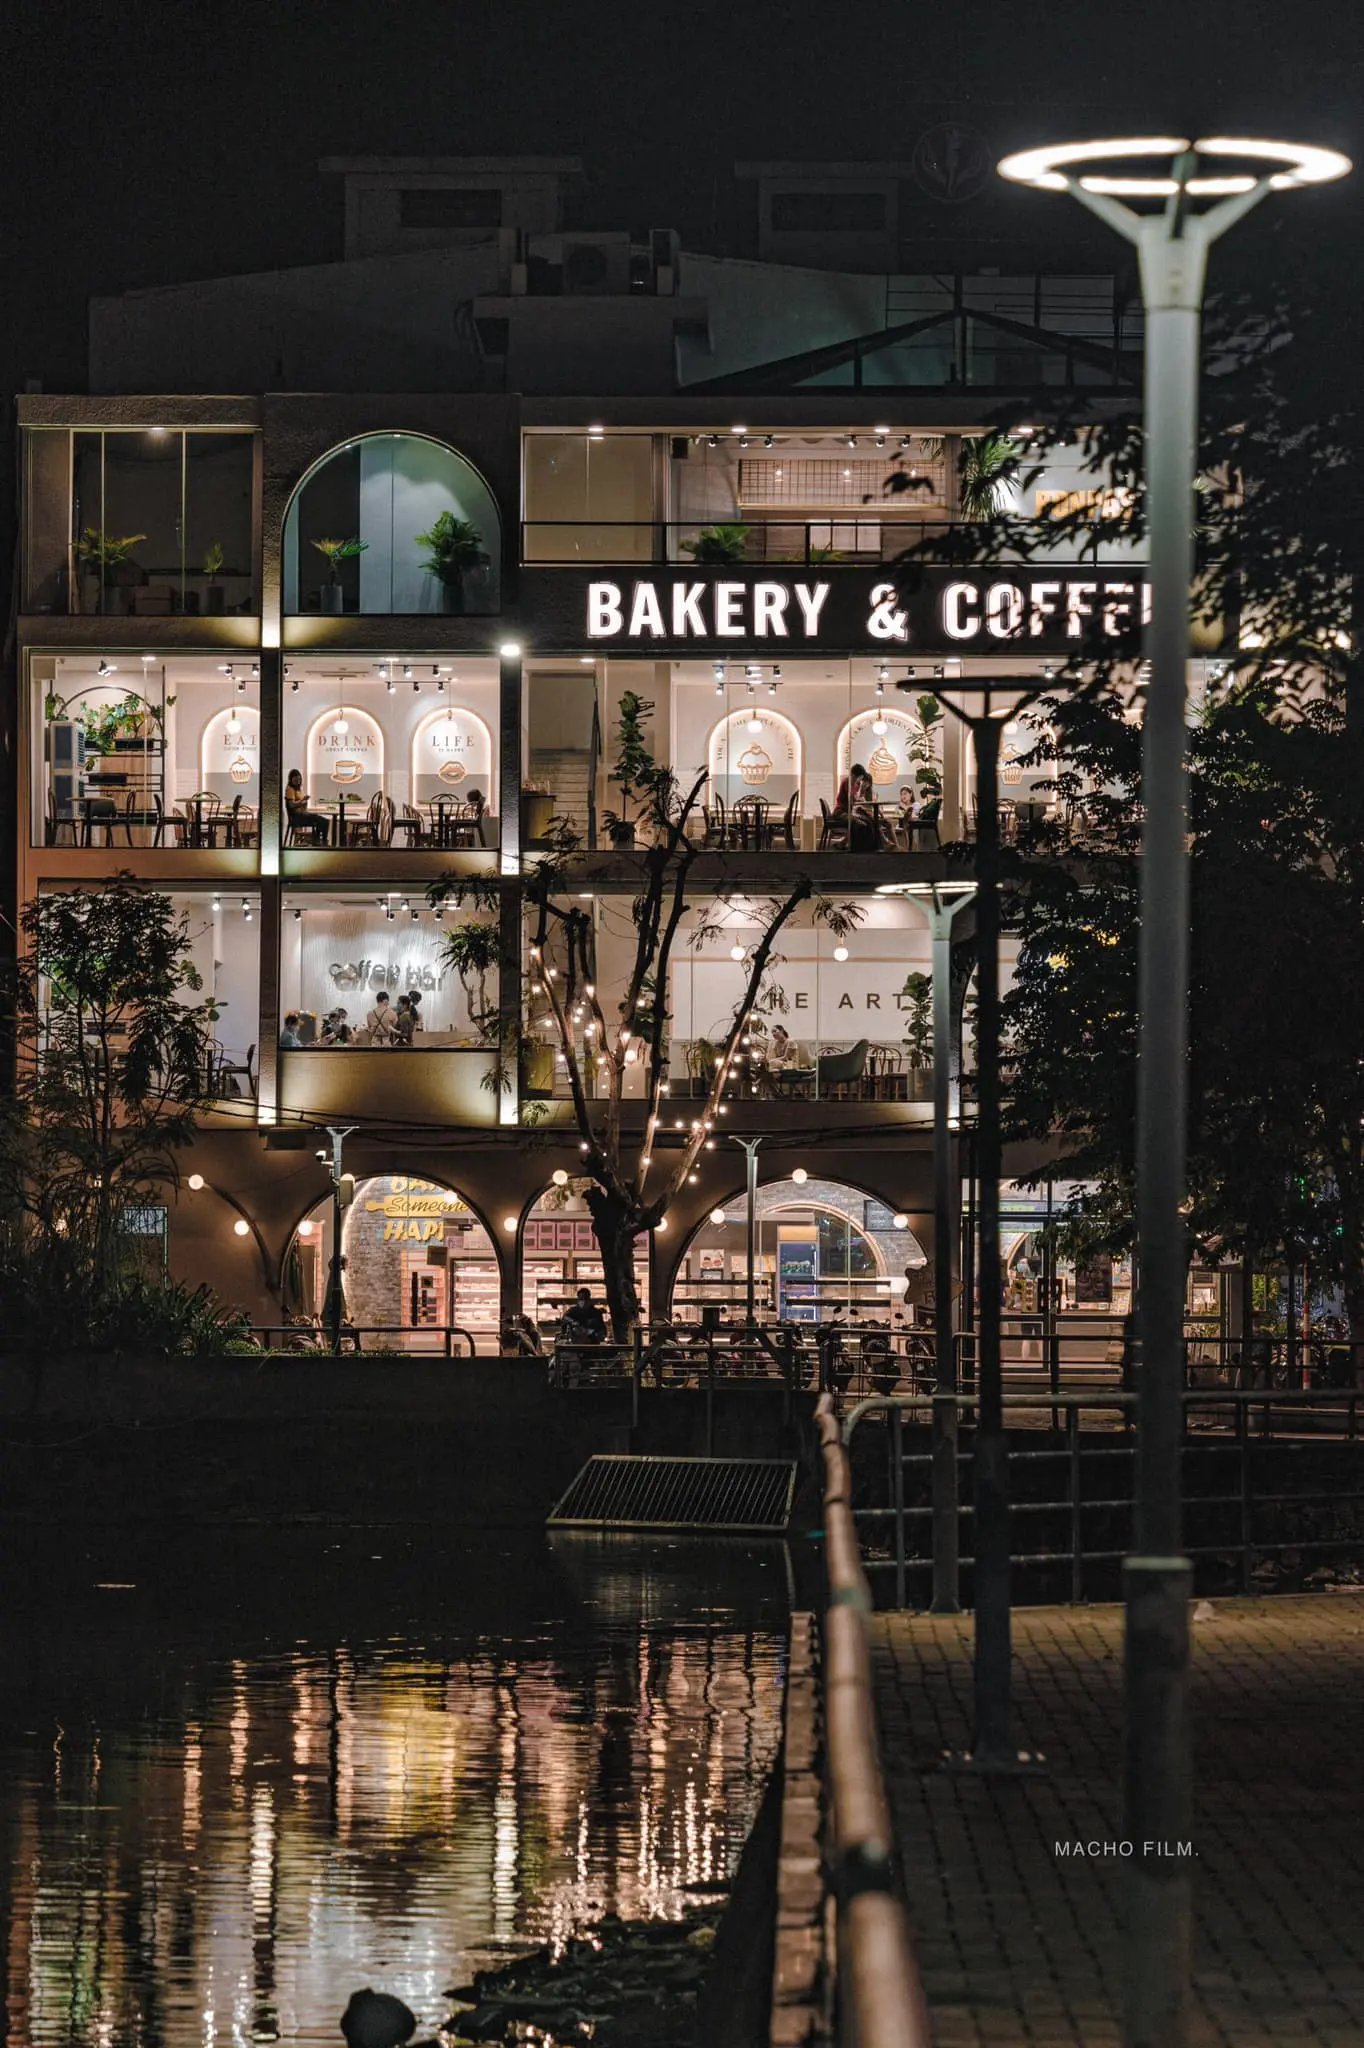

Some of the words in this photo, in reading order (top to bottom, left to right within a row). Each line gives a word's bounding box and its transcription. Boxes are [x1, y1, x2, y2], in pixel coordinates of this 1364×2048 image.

[585, 580, 831, 638] BAKERY
[866, 583, 909, 642] &
[318, 735, 376, 746] DRINK
[432, 735, 474, 747] LIFE
[768, 992, 809, 1009] HE
